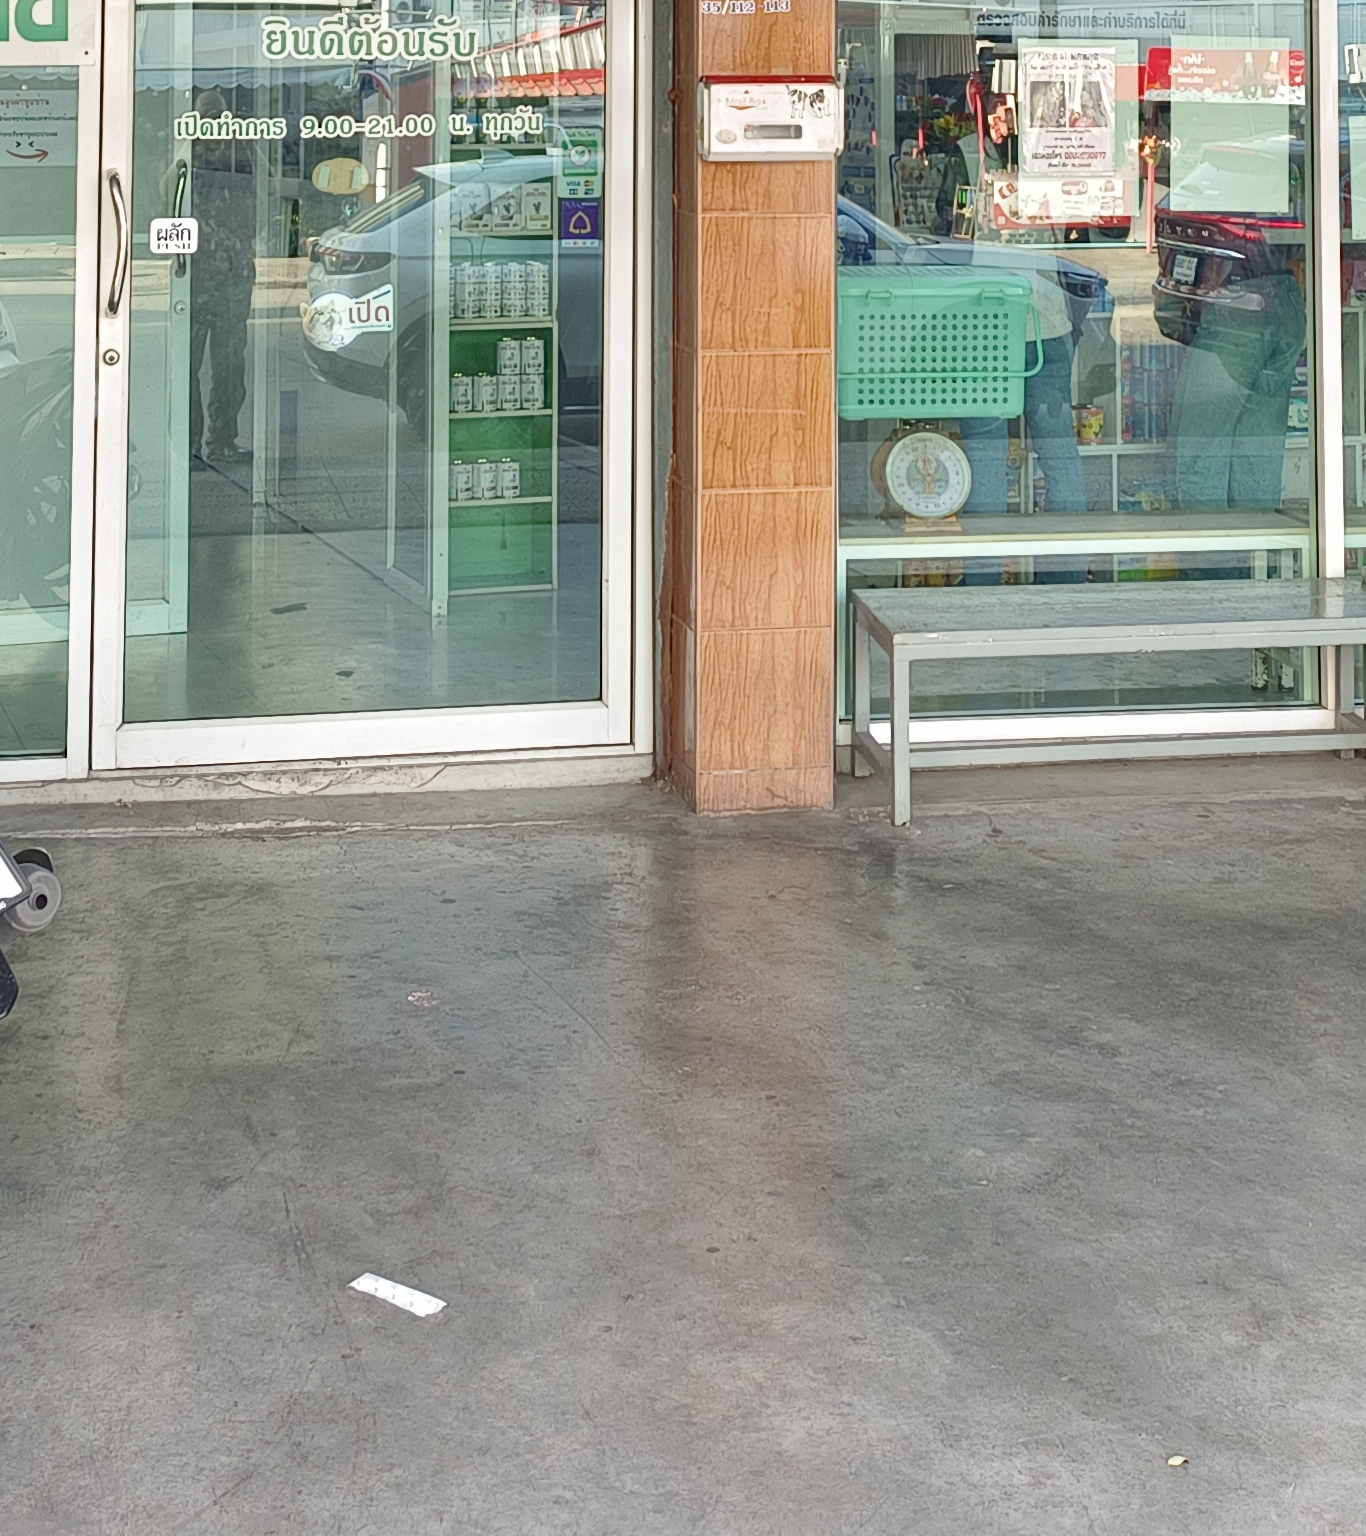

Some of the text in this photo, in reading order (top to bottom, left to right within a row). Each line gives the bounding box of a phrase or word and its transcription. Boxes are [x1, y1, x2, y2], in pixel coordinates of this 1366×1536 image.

[263, 15, 477, 60] ยินดีต้อนรับ
[175, 103, 544, 139] เปิดทำการ 9.00-21.00 น. ทุกวัน
[156, 222, 192, 242] ผลัก
[348, 298, 390, 324] เปิด
